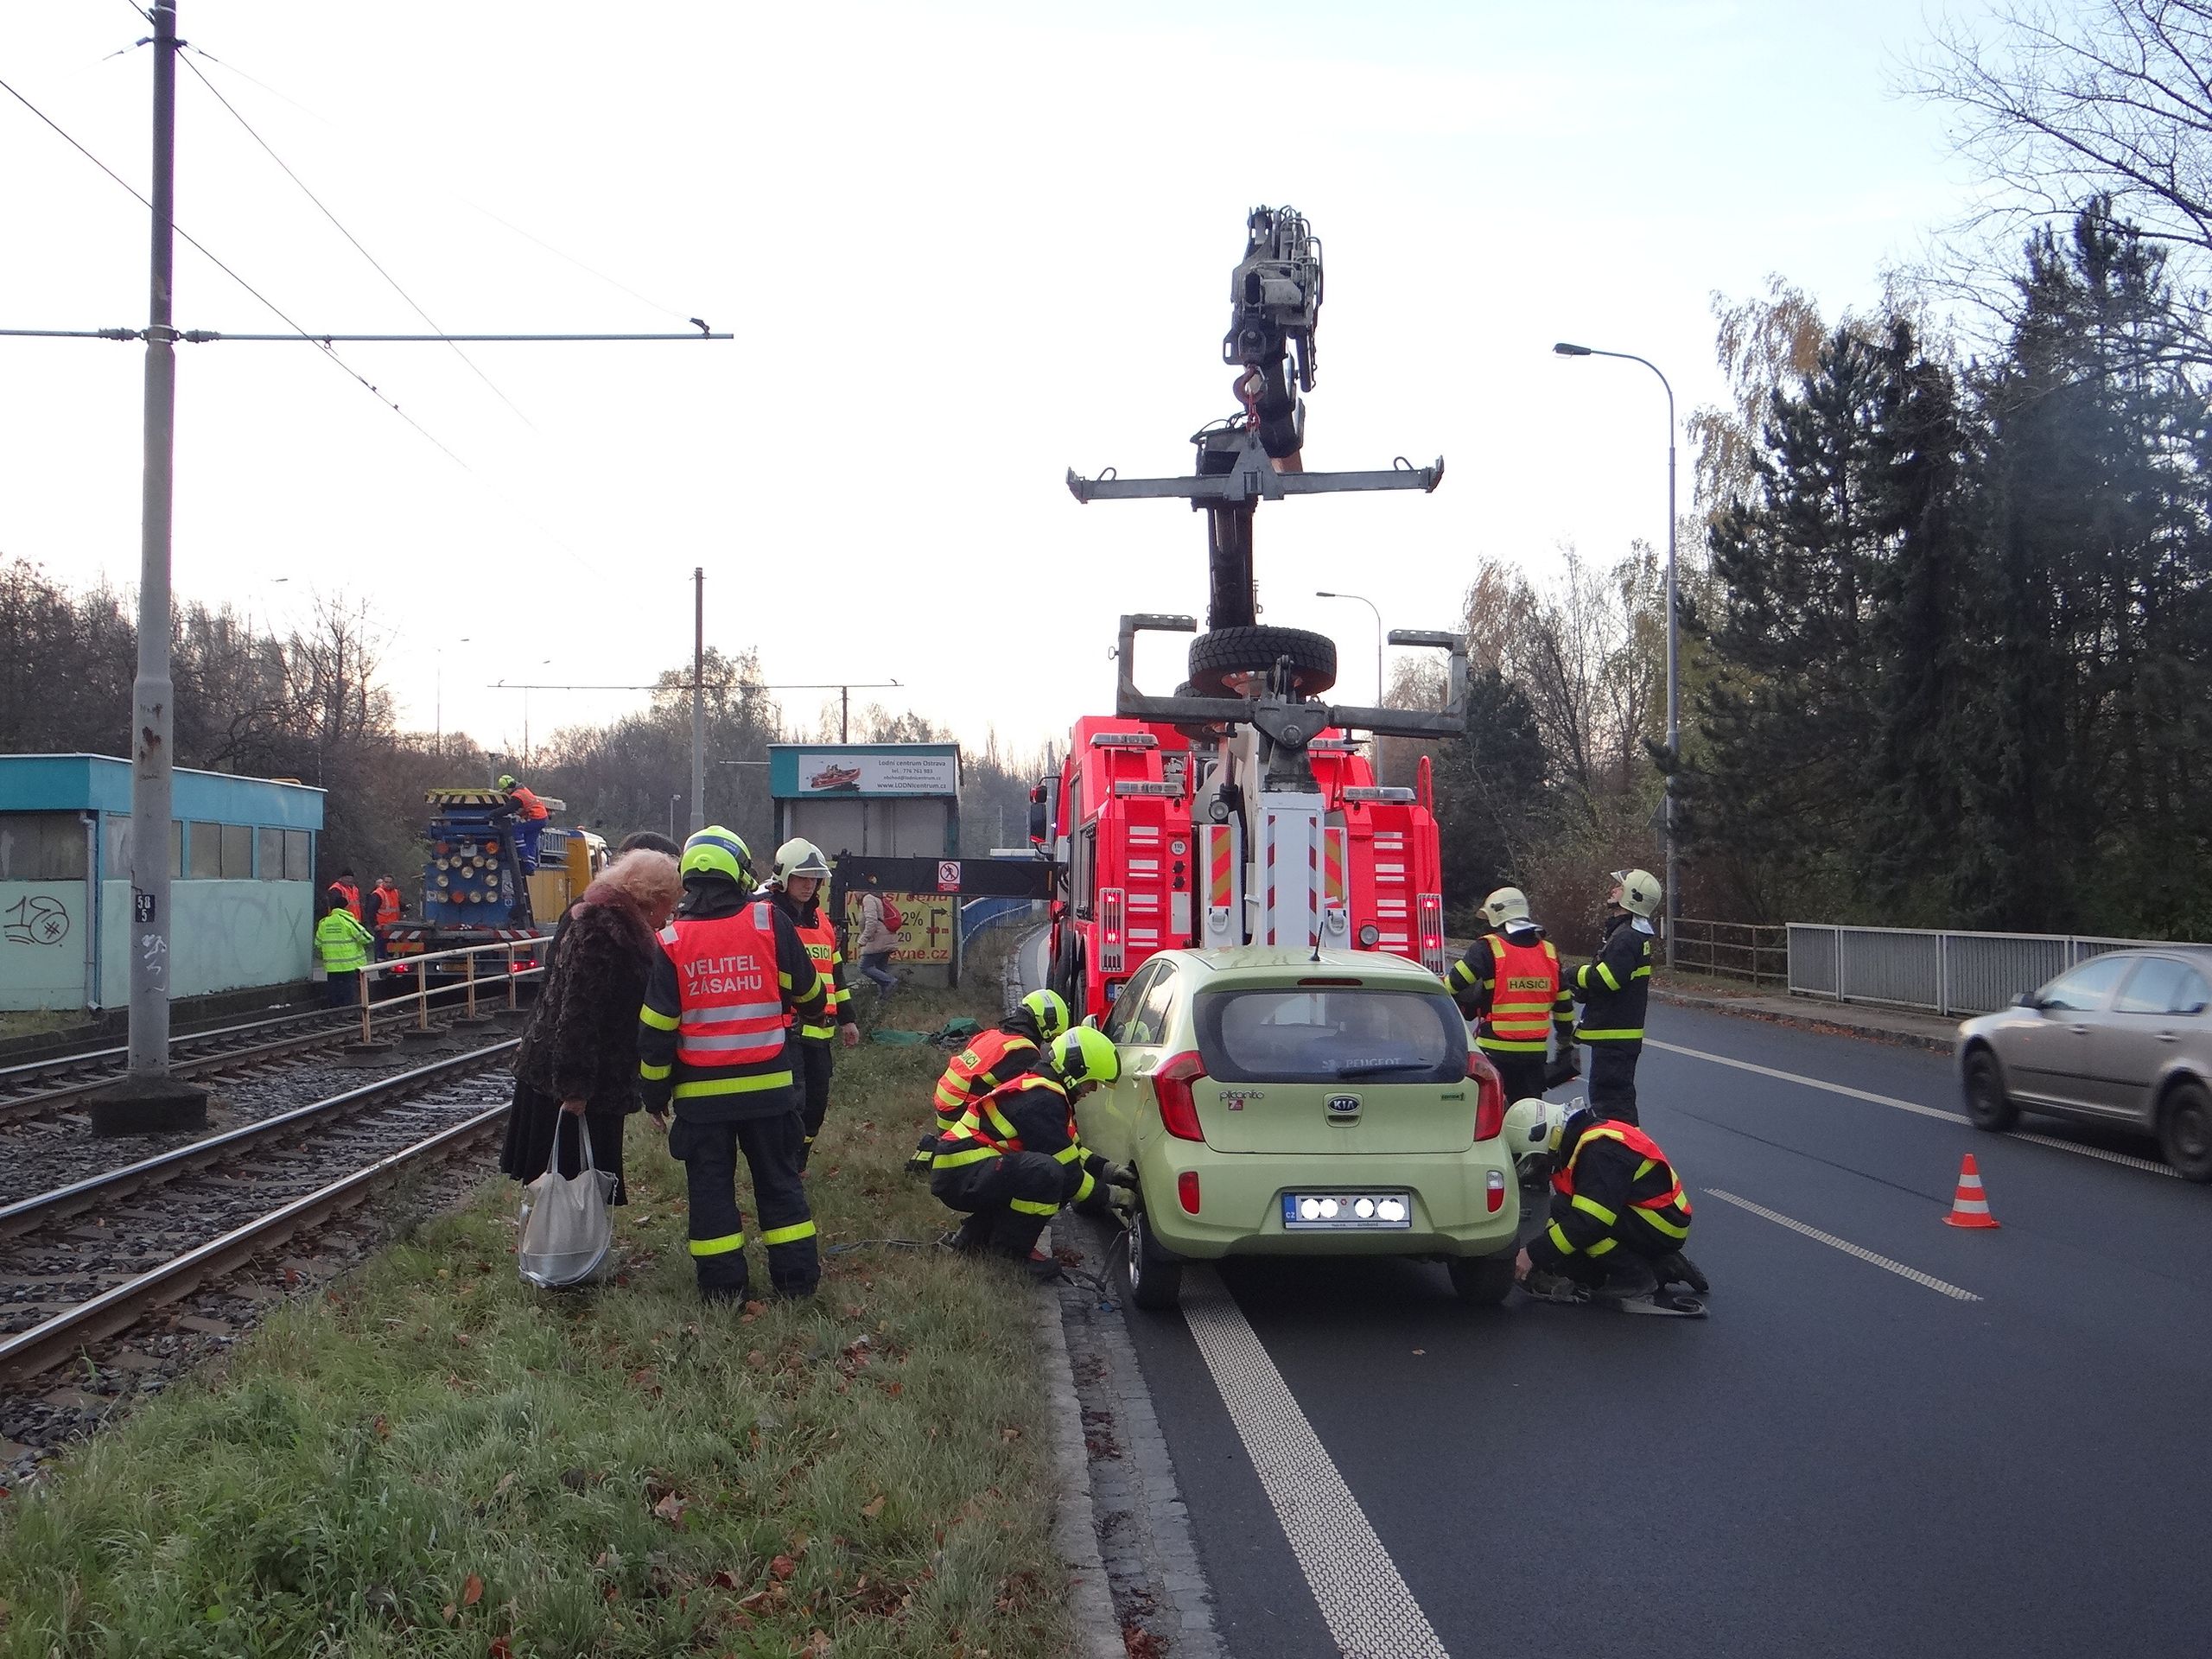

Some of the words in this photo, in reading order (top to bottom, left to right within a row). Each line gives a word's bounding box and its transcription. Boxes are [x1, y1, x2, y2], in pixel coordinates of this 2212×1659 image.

[137, 895, 151, 909] 58
[141, 908, 148, 922] 5
[804, 944, 830, 960] ASIČI
[683, 955, 761, 978] VELITEL
[687, 975, 762, 996] ZÁSAHU
[1510, 978, 1548, 989] HASIČI
[1345, 1058, 1402, 1069] PEUGEOT
[1219, 1090, 1265, 1102] picanto
[1333, 1100, 1355, 1109] KIA
